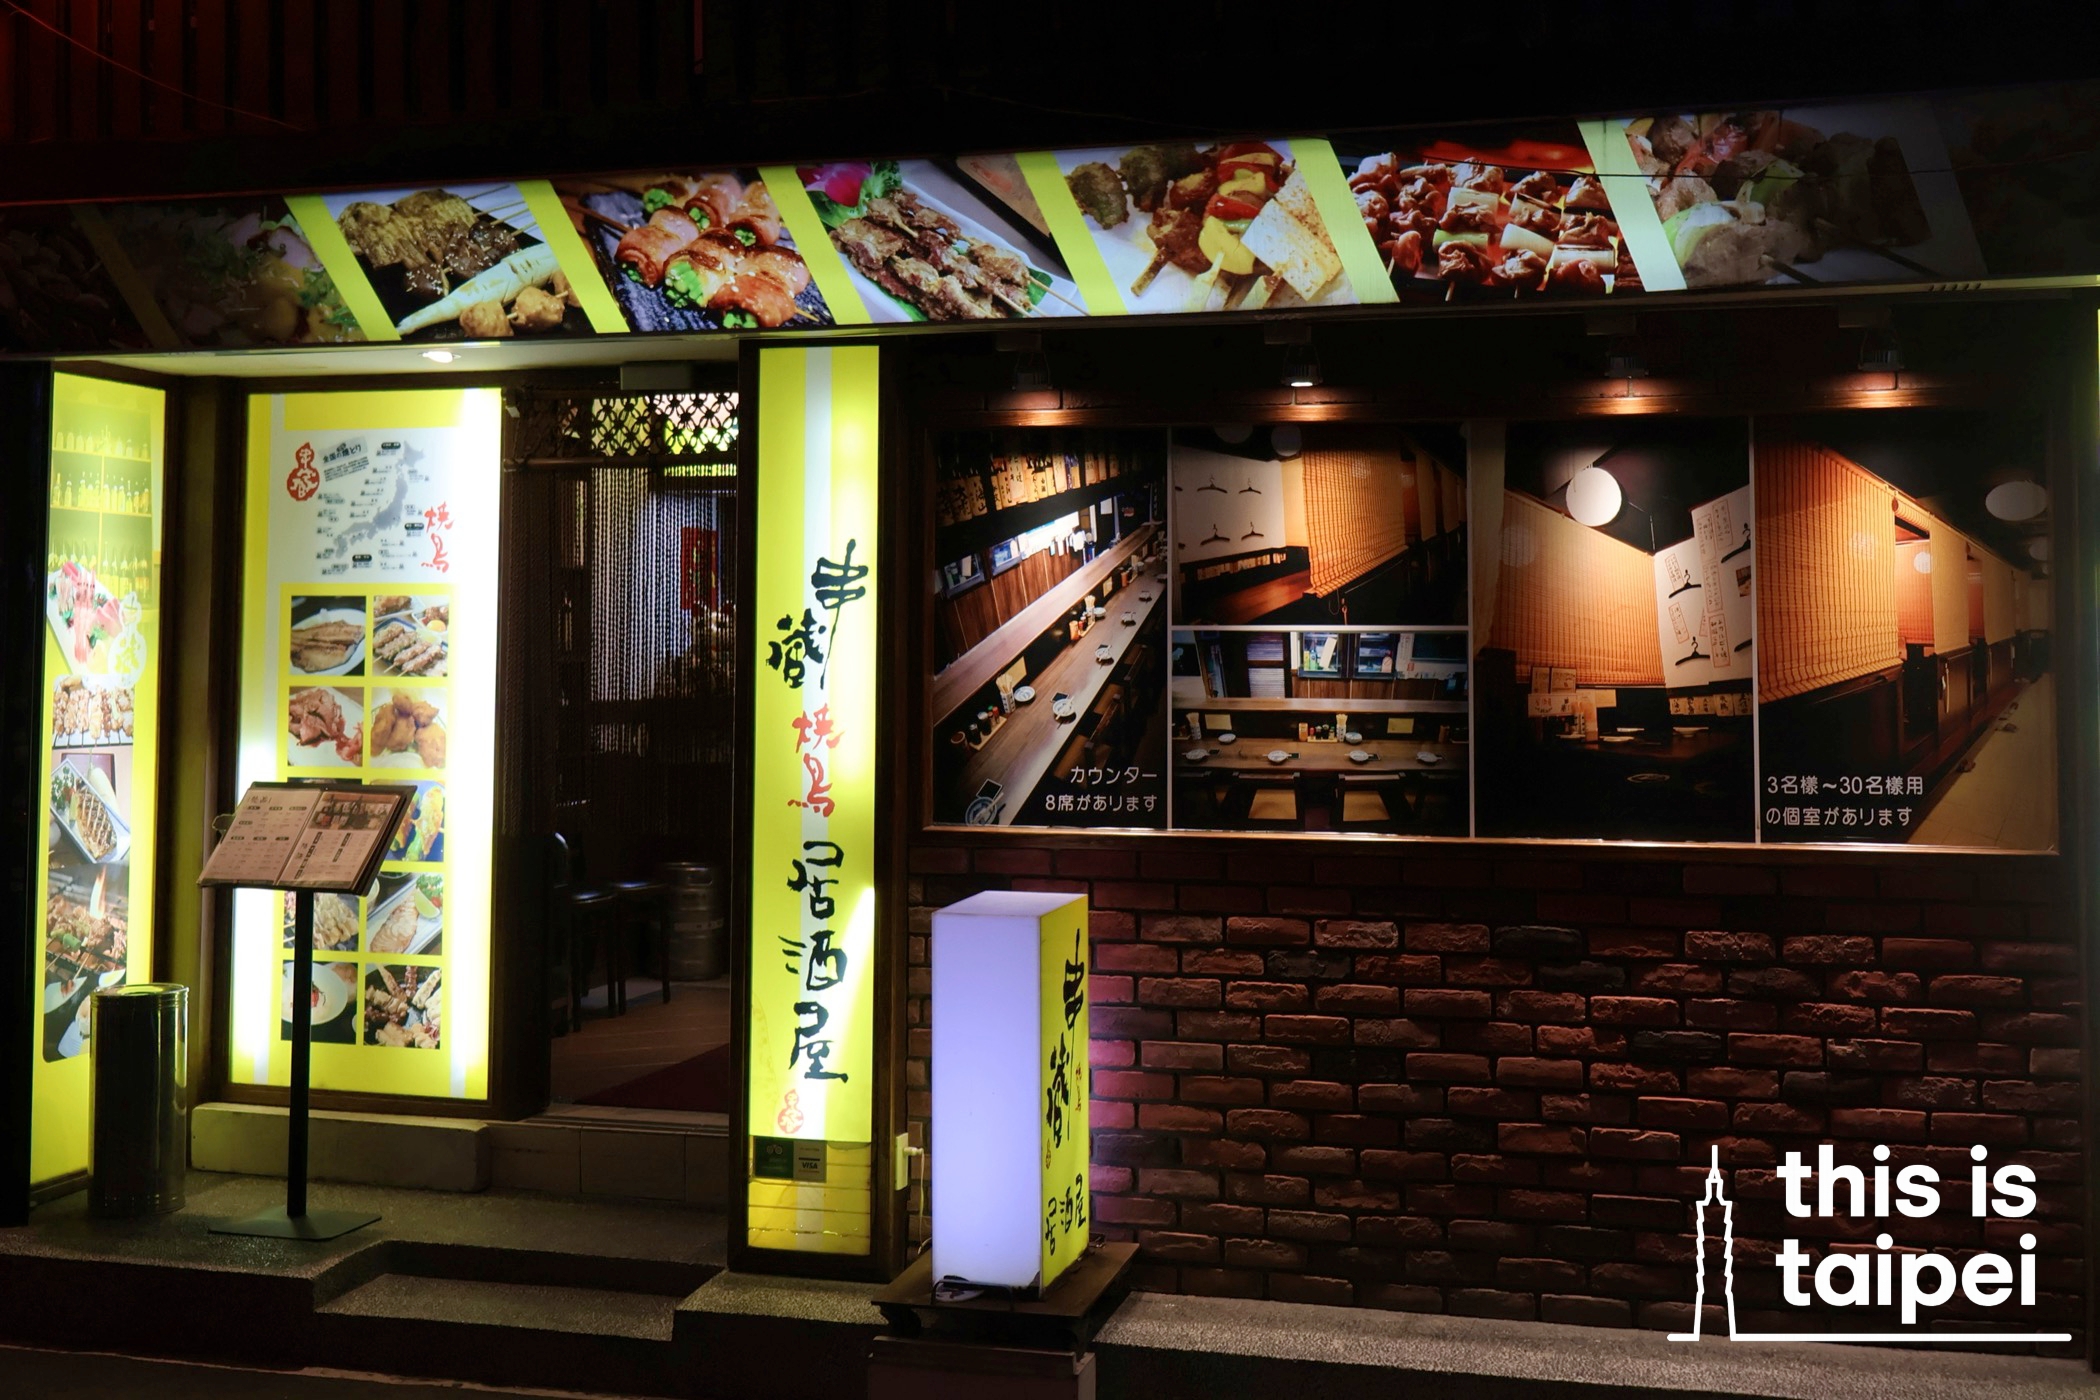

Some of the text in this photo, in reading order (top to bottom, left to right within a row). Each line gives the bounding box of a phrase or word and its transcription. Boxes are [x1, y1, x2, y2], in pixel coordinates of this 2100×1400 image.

[1070, 765, 1158, 785] カウンター
[1045, 794, 1158, 812] 8席があります
[1766, 806, 1912, 826] の個室があります
[778, 840, 849, 1084] 居酒屋
[801, 1161, 818, 1169] VISA
